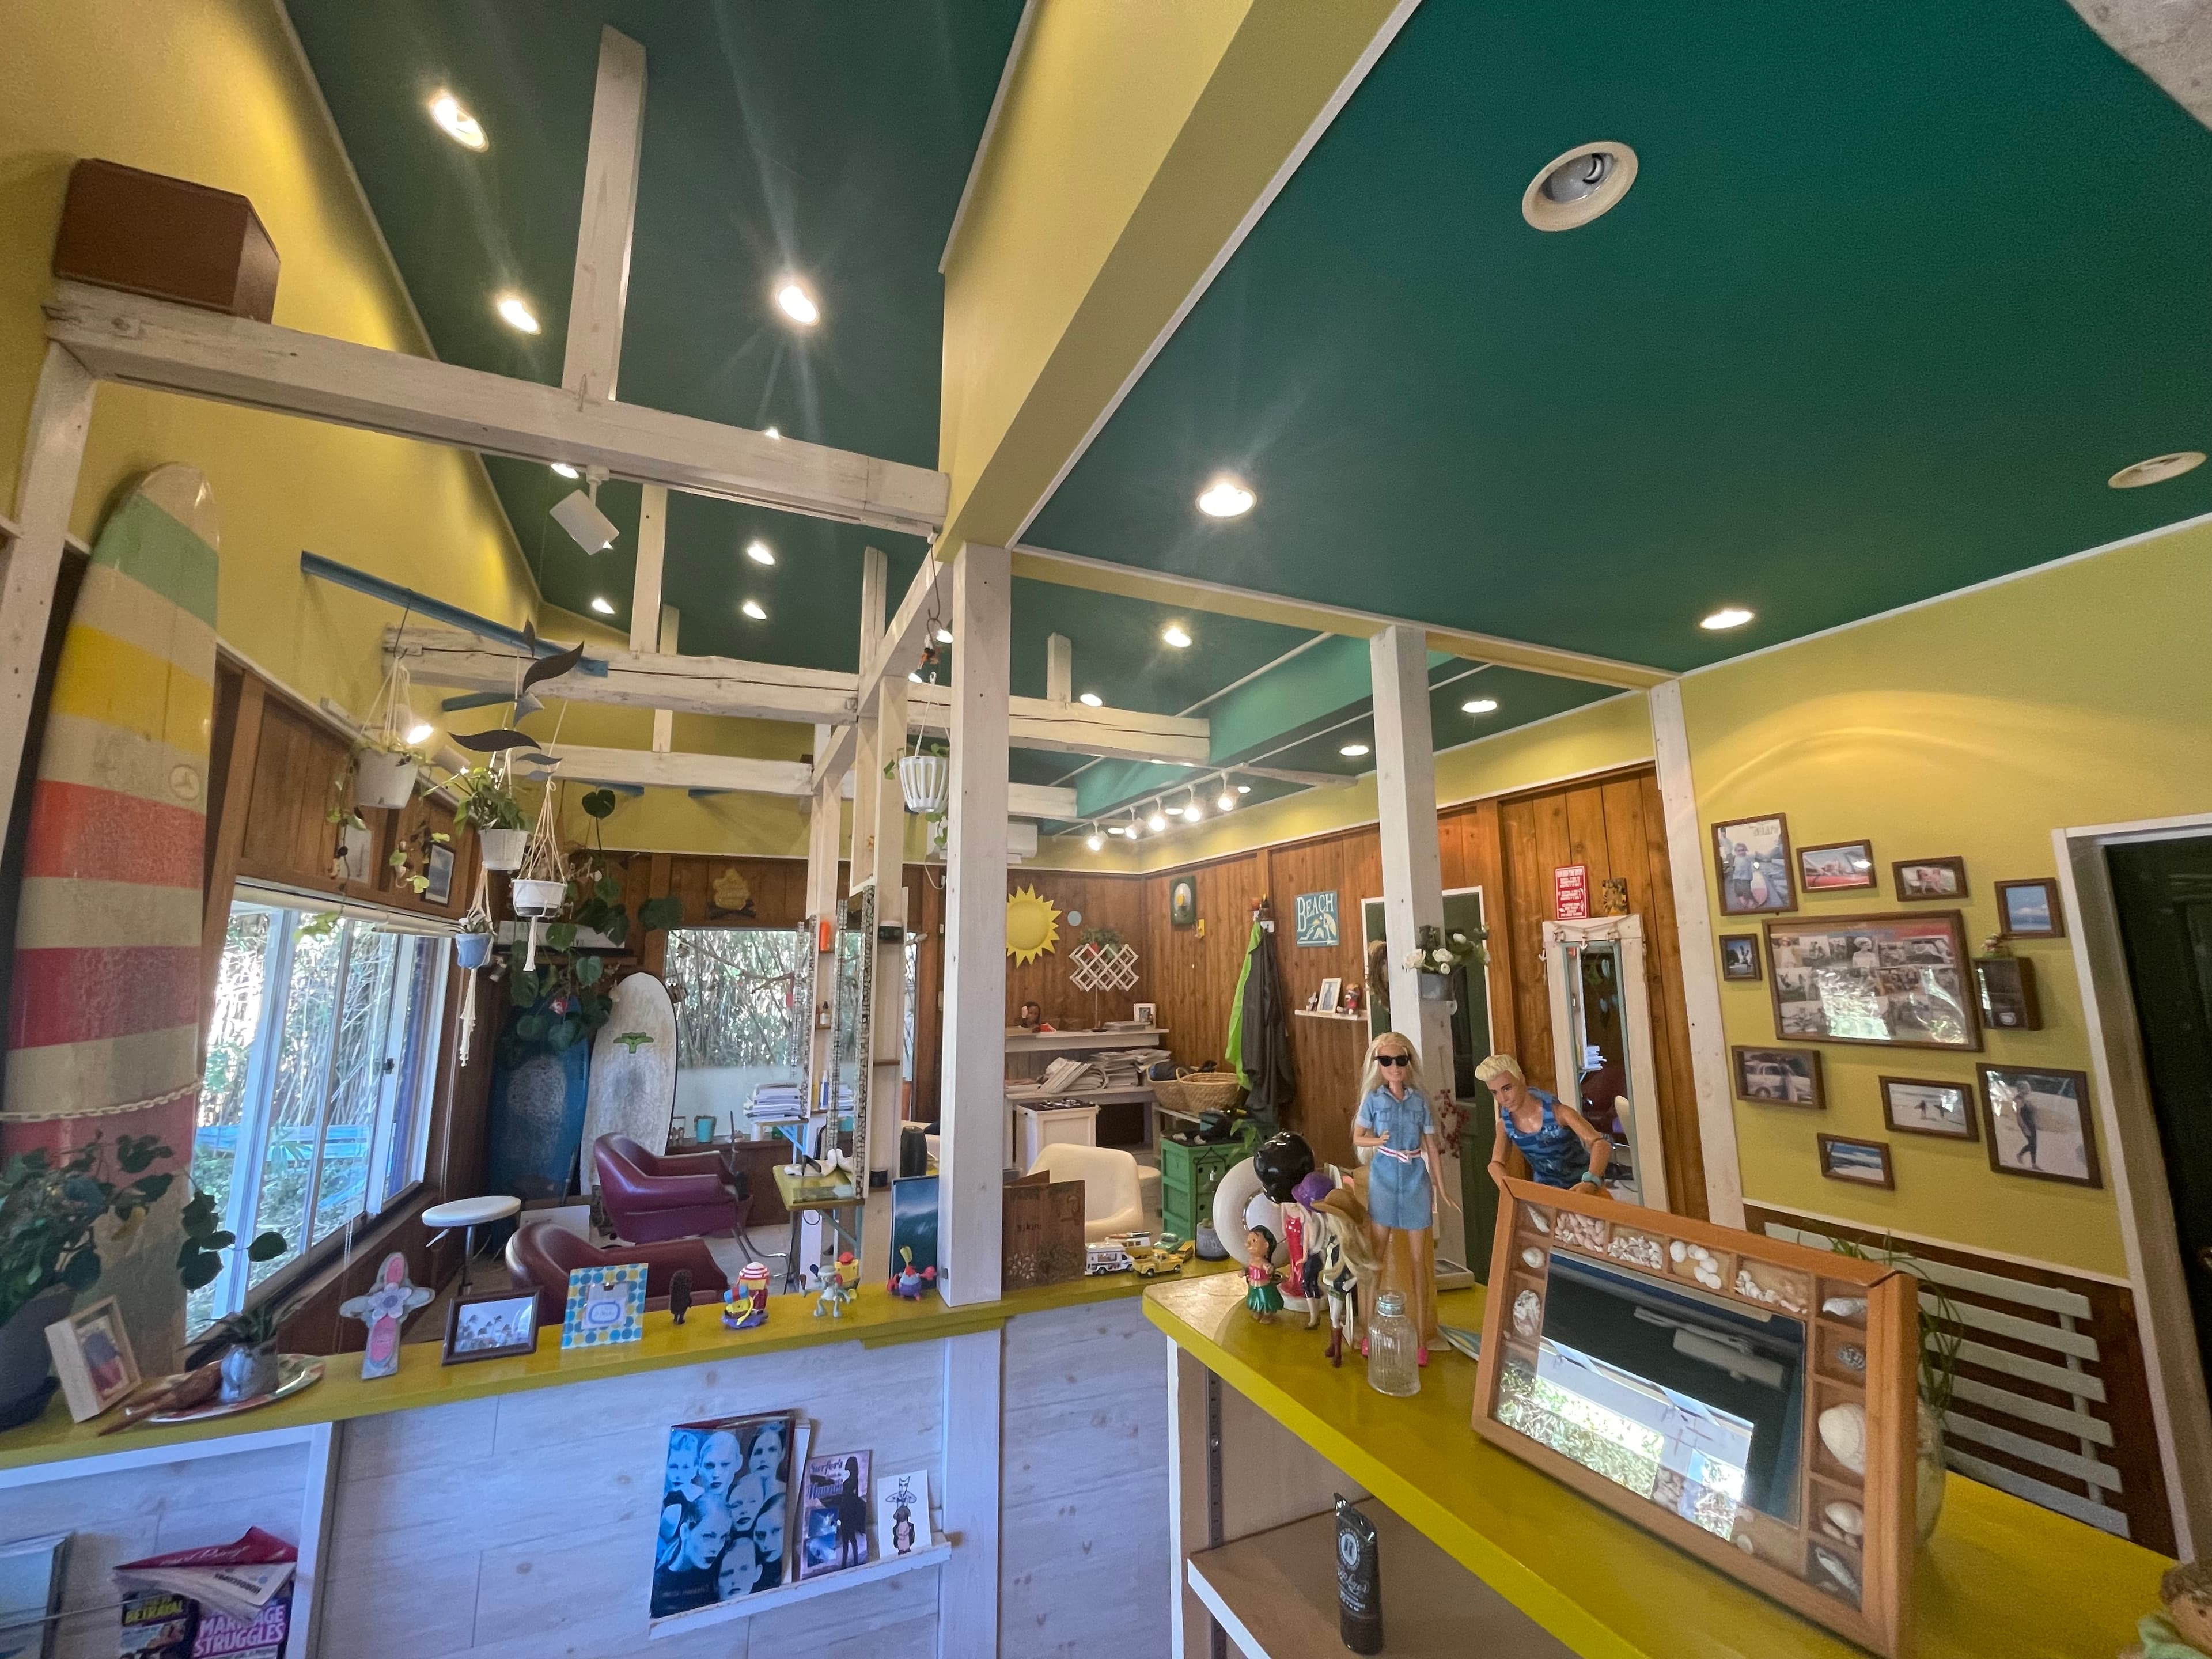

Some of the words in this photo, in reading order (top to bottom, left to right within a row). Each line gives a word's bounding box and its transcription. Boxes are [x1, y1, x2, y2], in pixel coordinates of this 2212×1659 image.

[1296, 893, 1334, 932] BEACH
[811, 1459, 843, 1475] Surfer's
[193, 1622, 285, 1658] STRUGGLES
